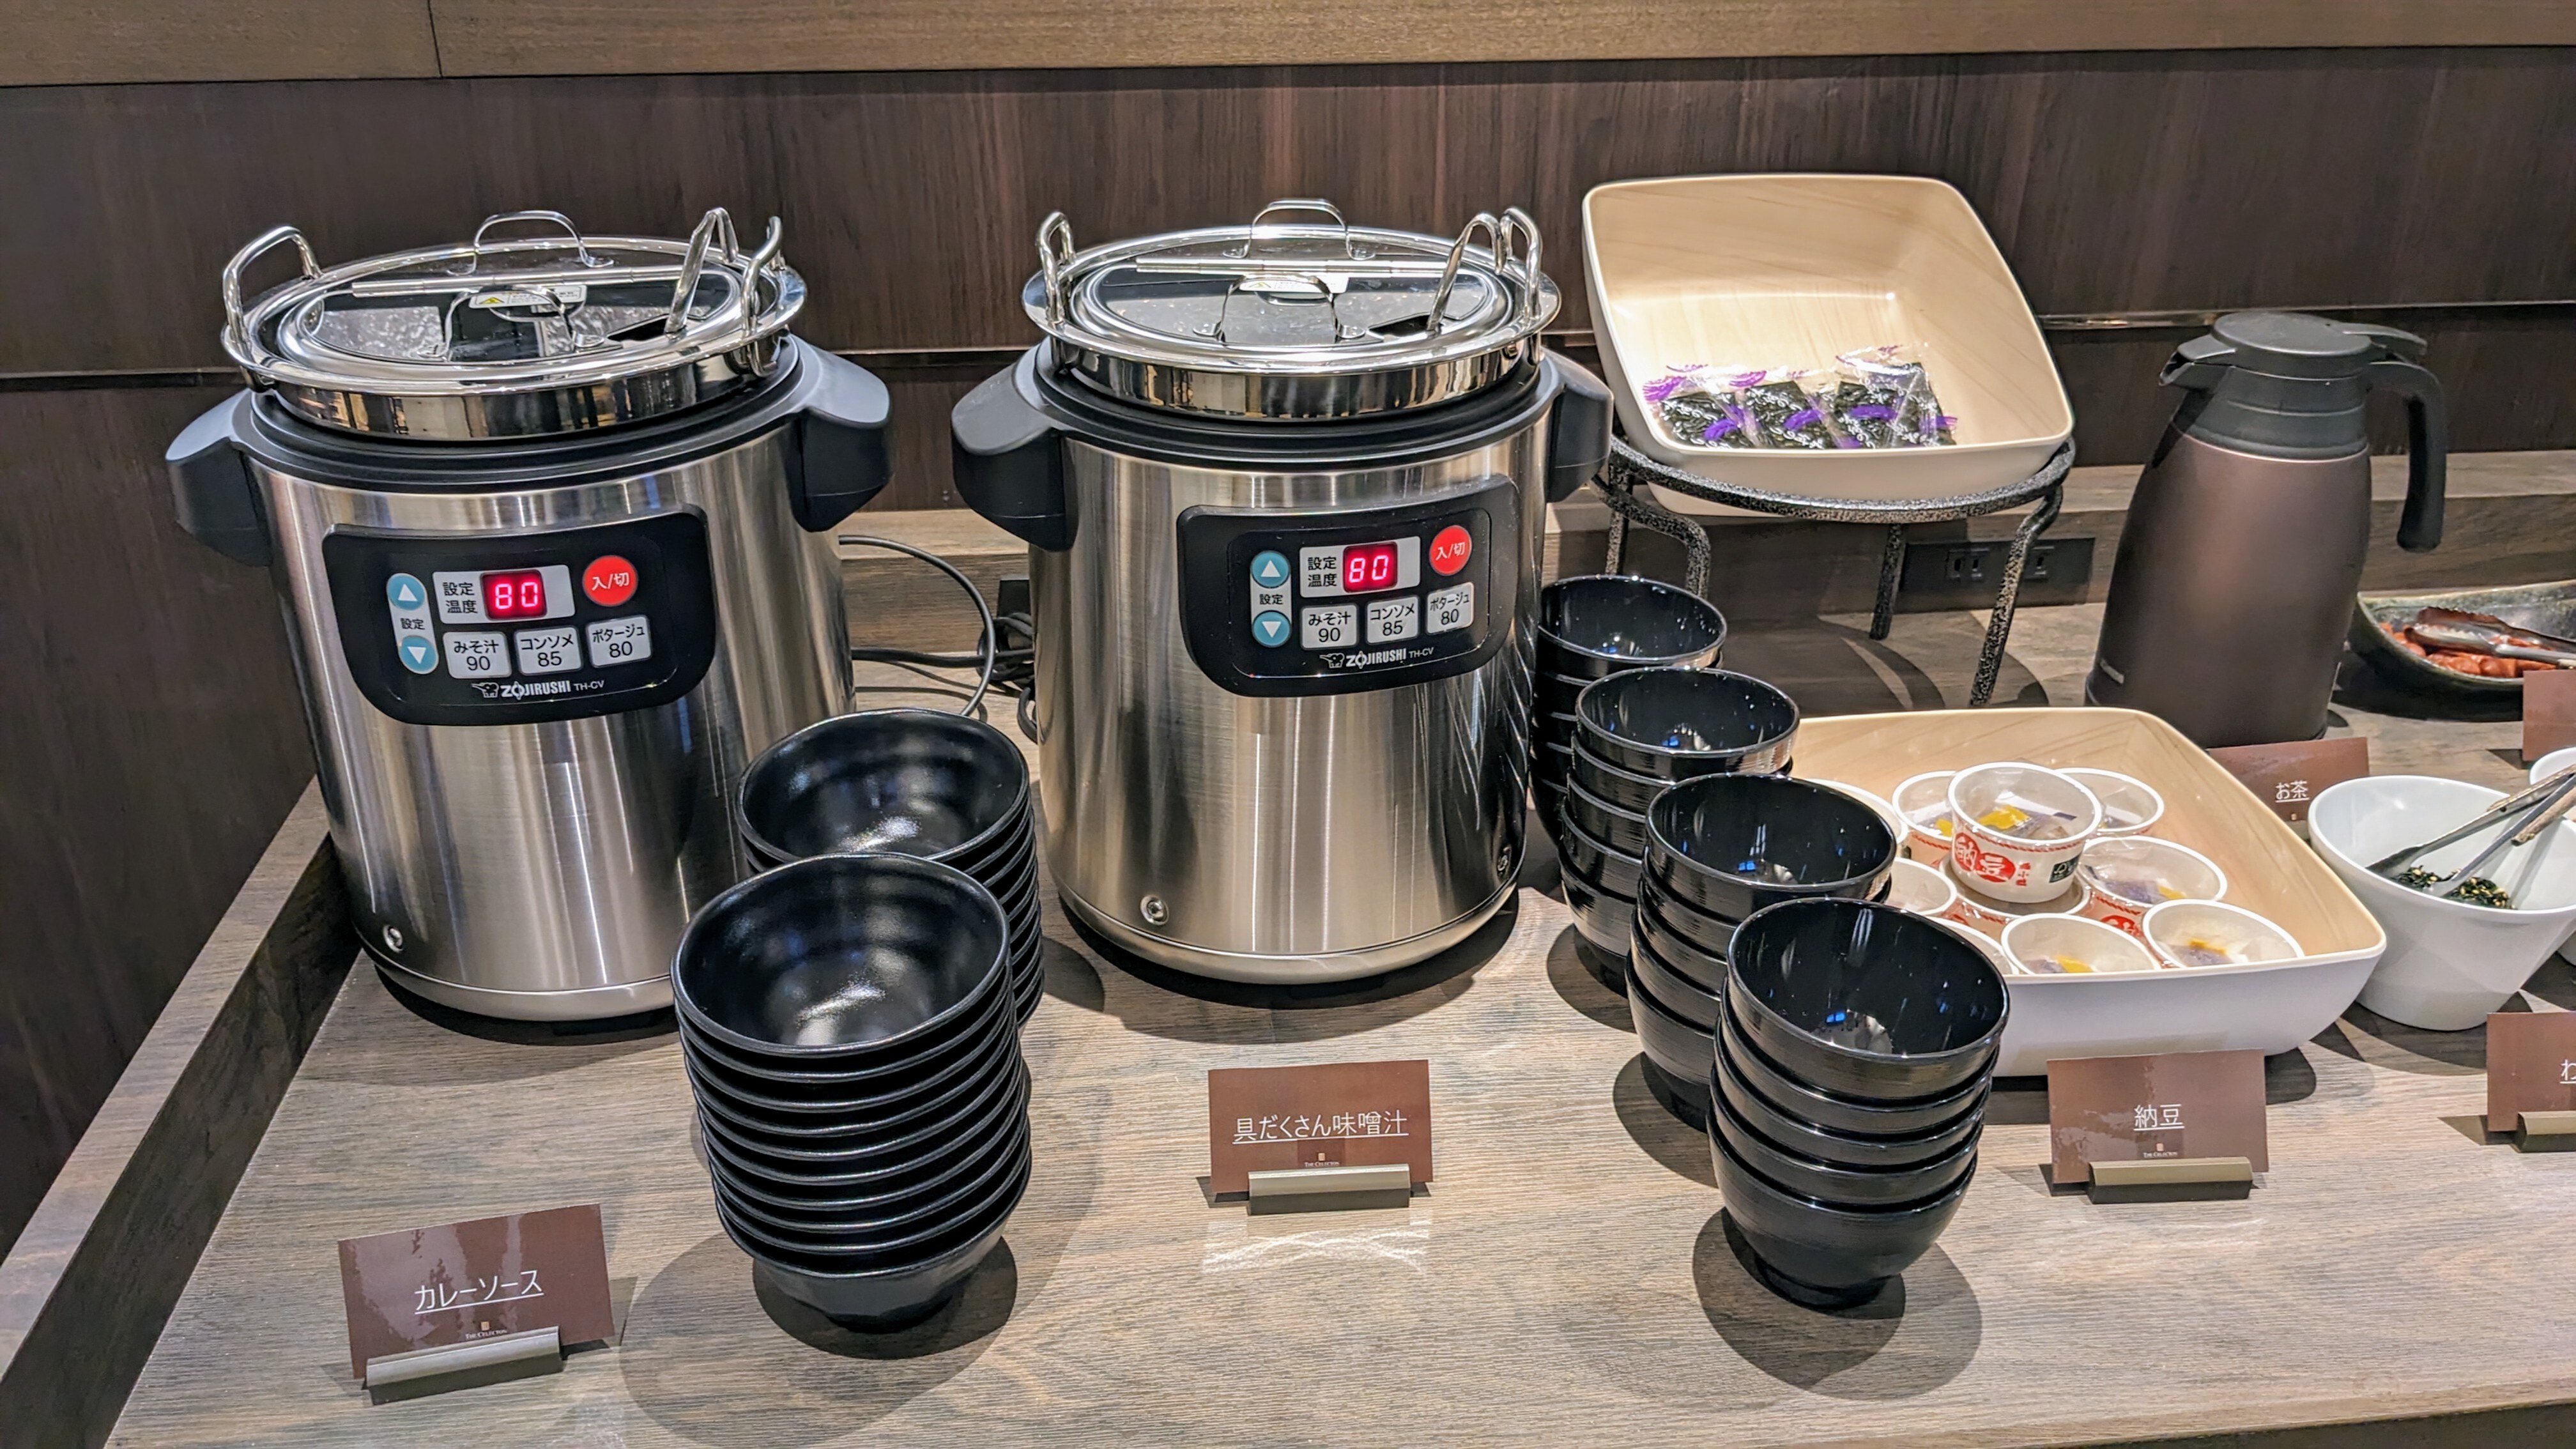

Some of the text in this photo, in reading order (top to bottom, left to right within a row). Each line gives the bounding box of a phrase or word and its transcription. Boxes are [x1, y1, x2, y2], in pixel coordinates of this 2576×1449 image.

[1436, 543, 1466, 562] 入/切
[1307, 556, 1337, 571] 設定
[1348, 555, 1388, 583] 80
[443, 582, 474, 597] 設定
[591, 572, 630, 592] 入/切
[1307, 573, 1338, 588] 温度
[494, 582, 539, 610] 80
[1259, 594, 1283, 605] 設定
[1429, 591, 1470, 612] ポタージュ
[446, 599, 478, 615] 温度
[1370, 602, 1415, 621] コンソメ
[400, 618, 425, 631] 設定
[1308, 611, 1351, 627] みそ汁
[1441, 609, 1460, 625] 80
[592, 624, 646, 645] ポタージュ
[1318, 627, 1341, 643] 90
[1382, 620, 1404, 637] 85
[453, 639, 500, 655] みそ汁
[520, 634, 574, 650] コンソメ
[609, 640, 634, 658] 80
[467, 656, 491, 672] 90
[537, 650, 563, 668] 85
[1346, 647, 1434, 669] ZOJIRUSHI TH-CV
[500, 680, 605, 700] ZOJIRUSHI TH-CV
[2275, 780, 2309, 800] お茶
[2133, 1103, 2183, 1128] 納豆
[1233, 1108, 1407, 1142] 具だくさん味噌汁
[414, 1269, 543, 1311] カレーソース
